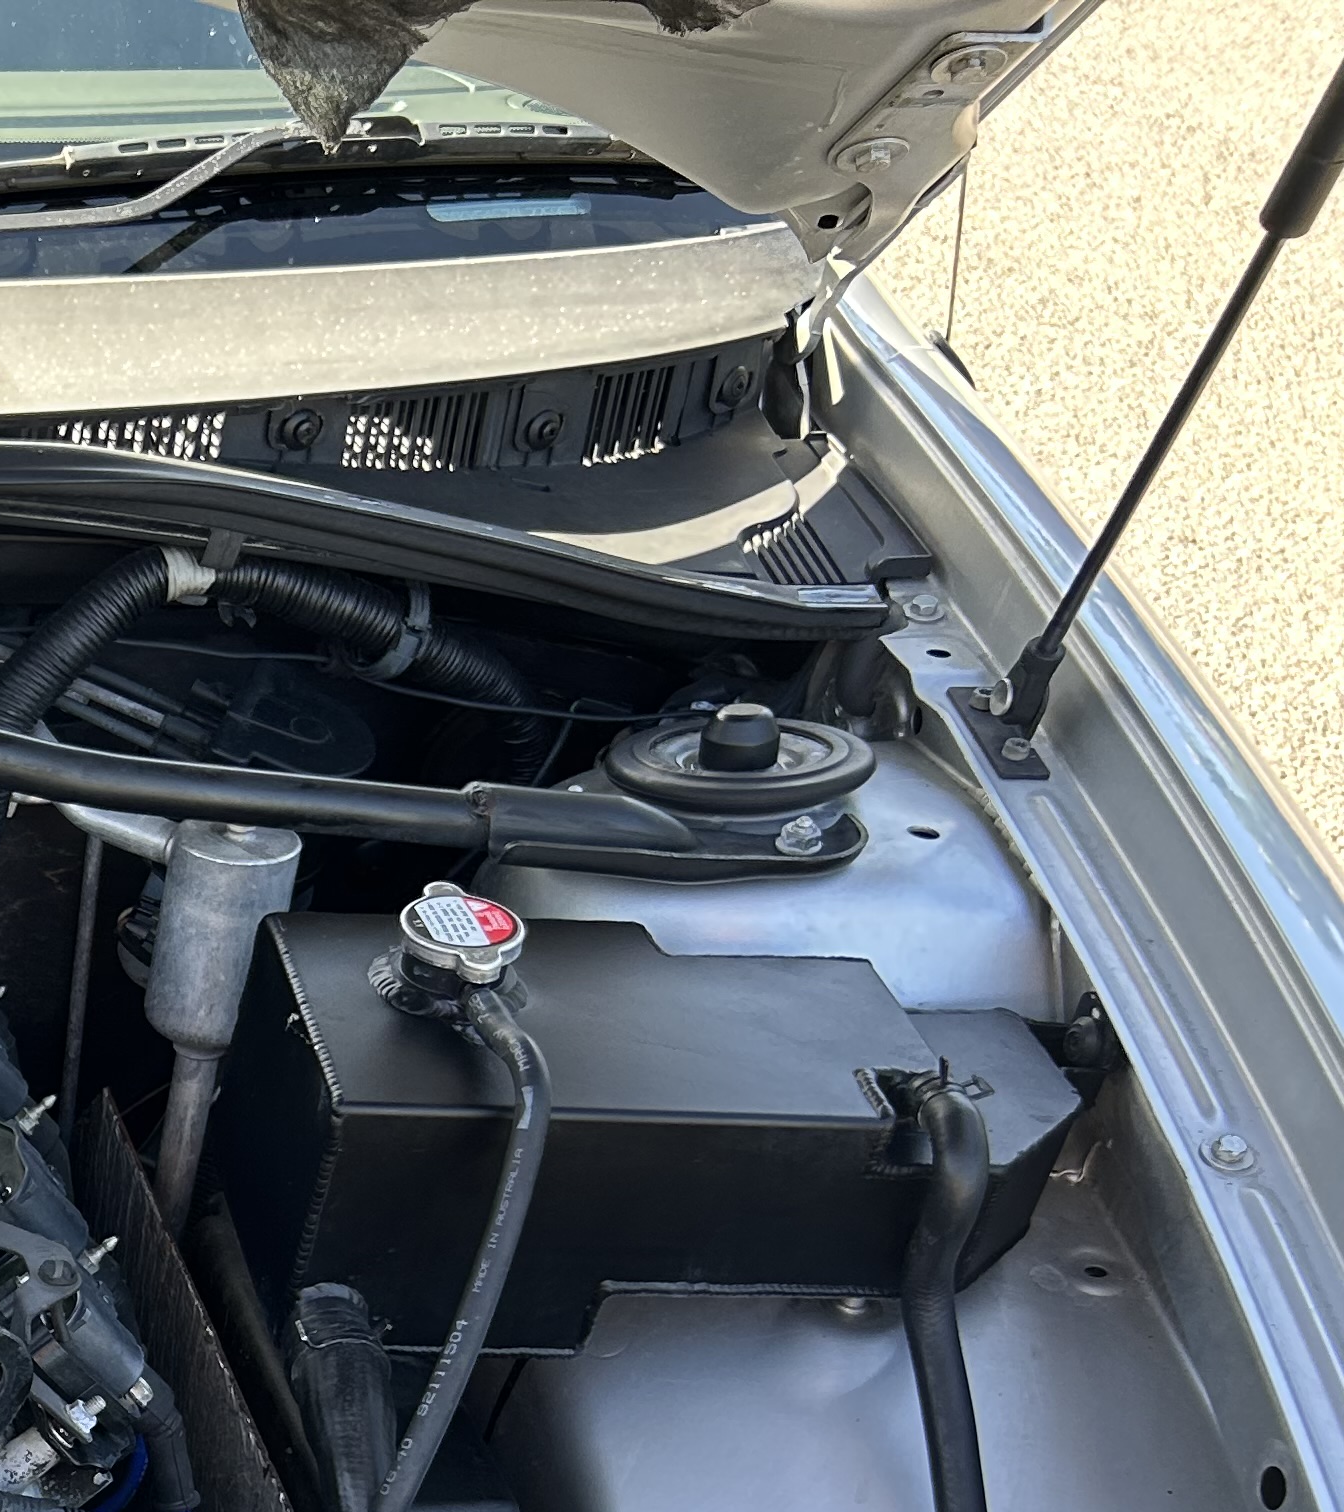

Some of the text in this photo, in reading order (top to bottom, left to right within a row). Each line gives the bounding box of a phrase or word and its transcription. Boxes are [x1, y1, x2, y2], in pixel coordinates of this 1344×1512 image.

[472, 1258, 491, 1293] MADE
[487, 1232, 500, 1249] IN
[496, 1148, 524, 1226] AUSTRALIA
